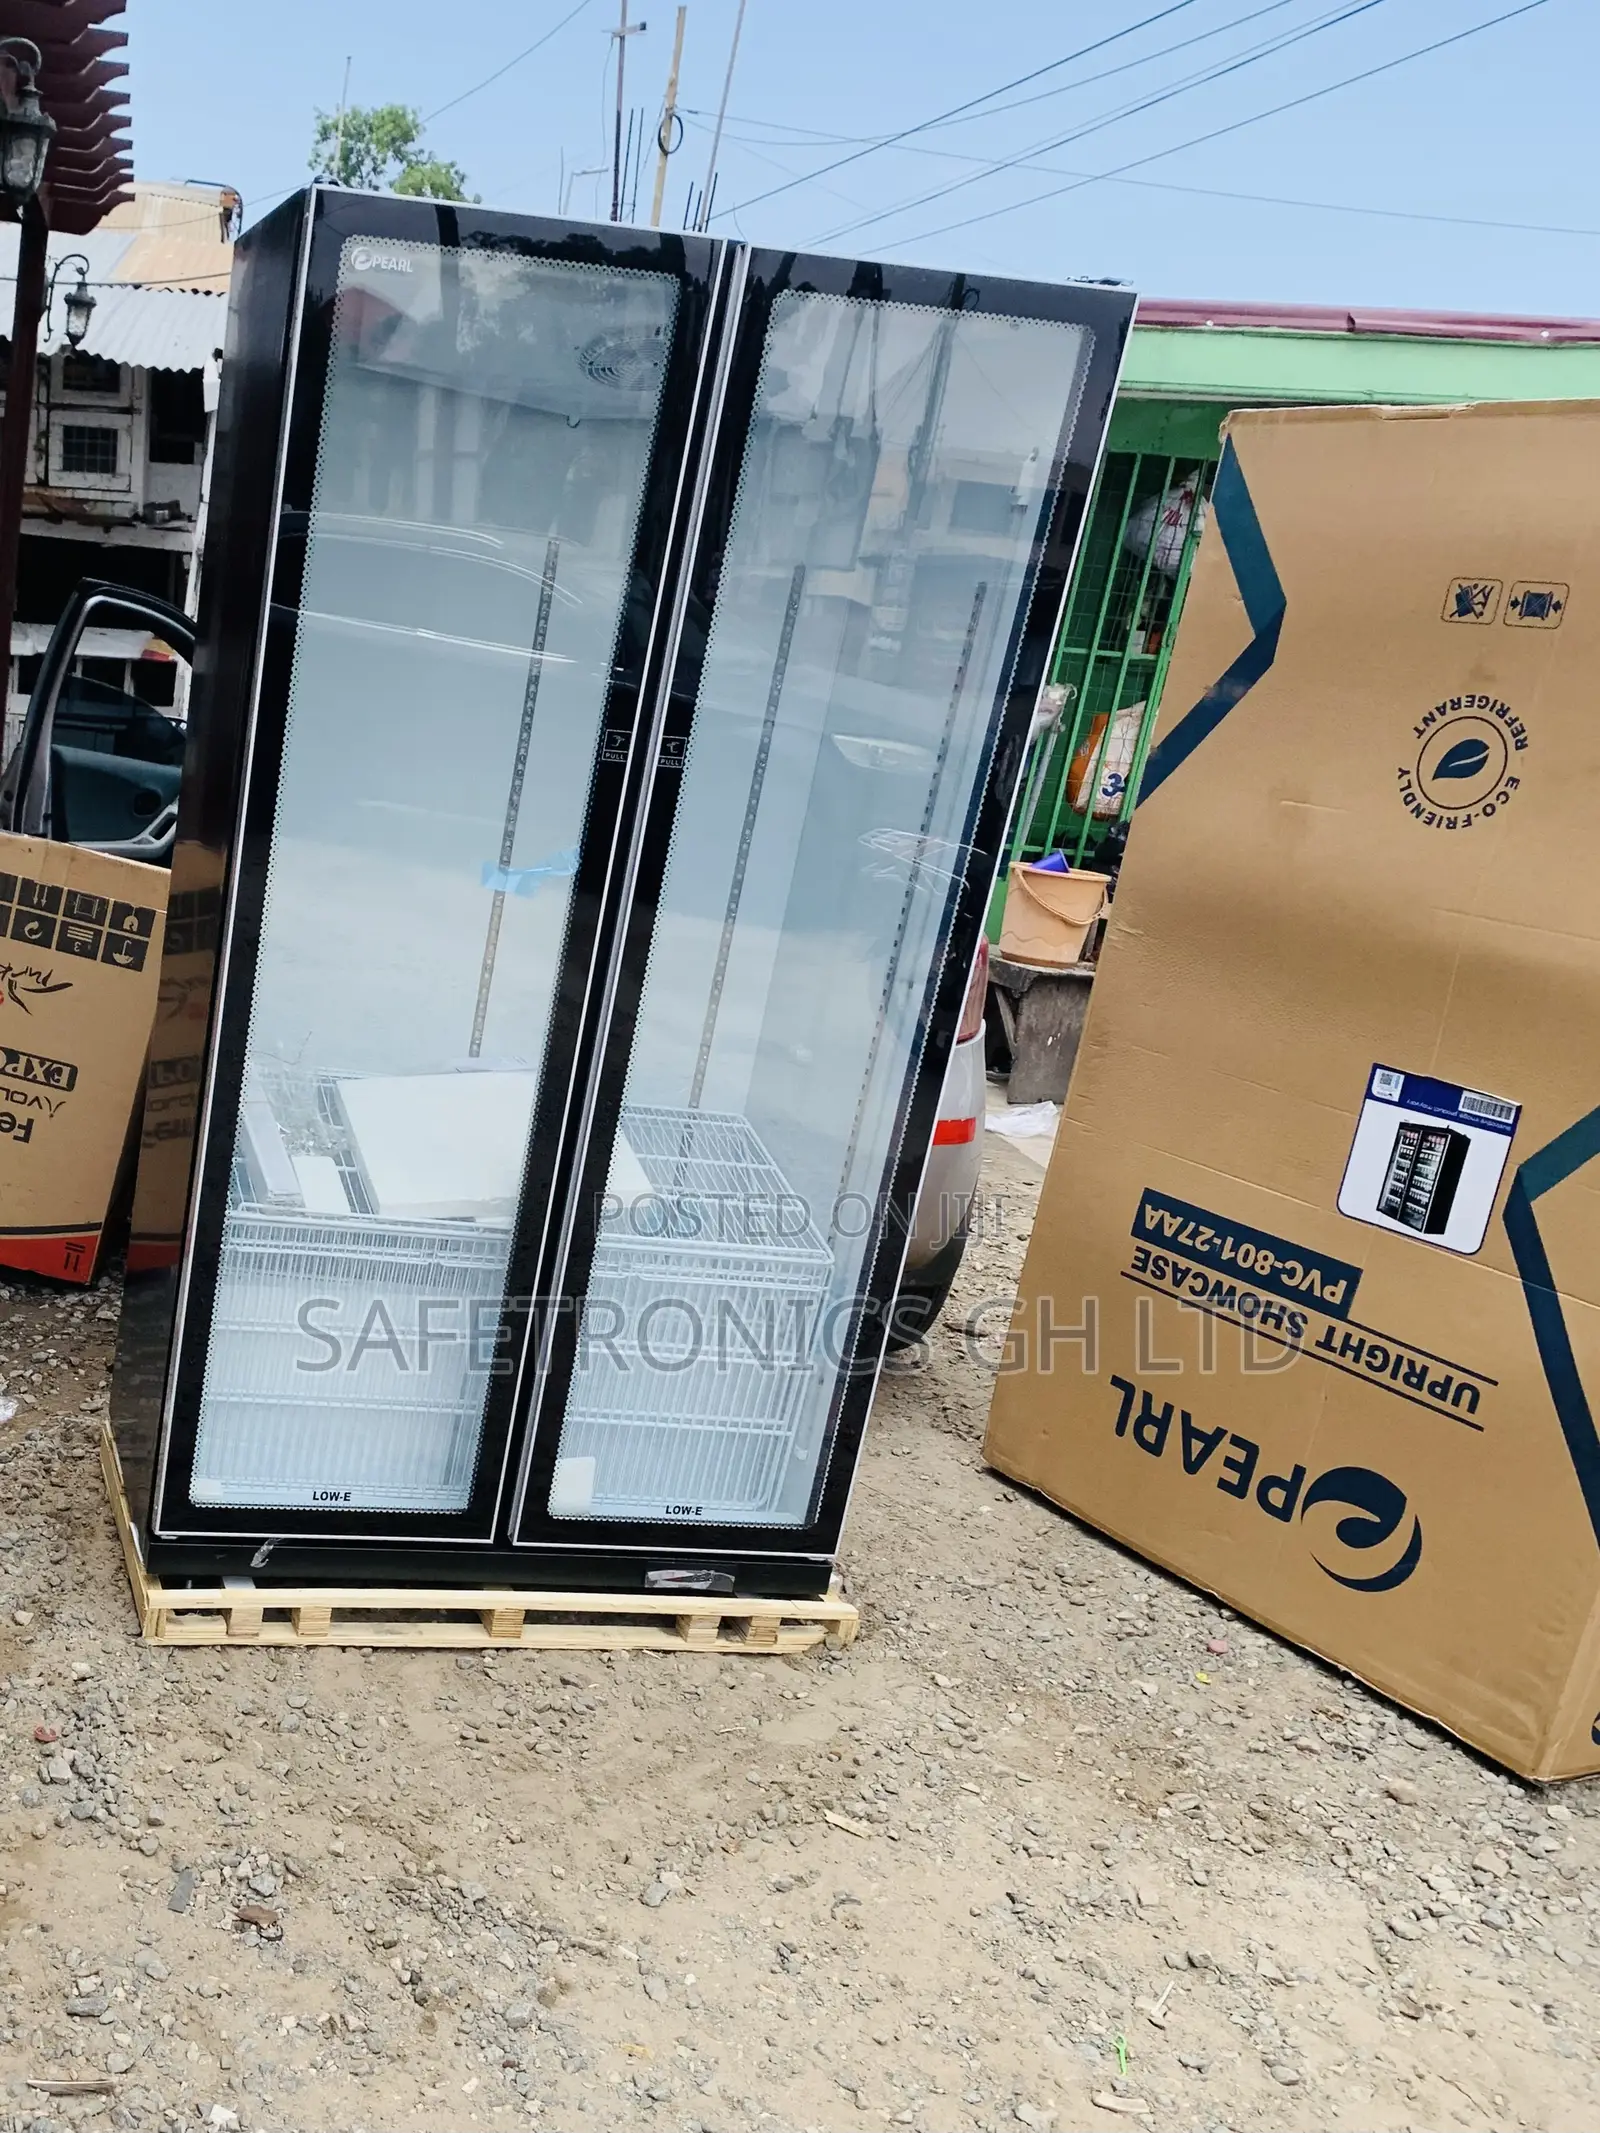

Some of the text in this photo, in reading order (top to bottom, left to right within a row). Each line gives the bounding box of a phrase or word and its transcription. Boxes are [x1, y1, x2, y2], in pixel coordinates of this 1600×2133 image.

[372, 255, 413, 273] PEARL
[1412, 694, 1529, 751] REFRIGERANT
[605, 752, 625, 760] PULL
[660, 758, 680, 766] PULL
[1397, 767, 1521, 830] ECO-FRIENDLY
[73, 941, 81, 952] 3
[1143, 1203, 1349, 1305] PVC-801-27AA
[1131, 1245, 1481, 1415] UPRIGHT SHOWCASE
[1109, 1374, 1307, 1523] PEARL
[312, 1490, 352, 1502] LOW-E
[665, 1504, 704, 1516] LOW-E
